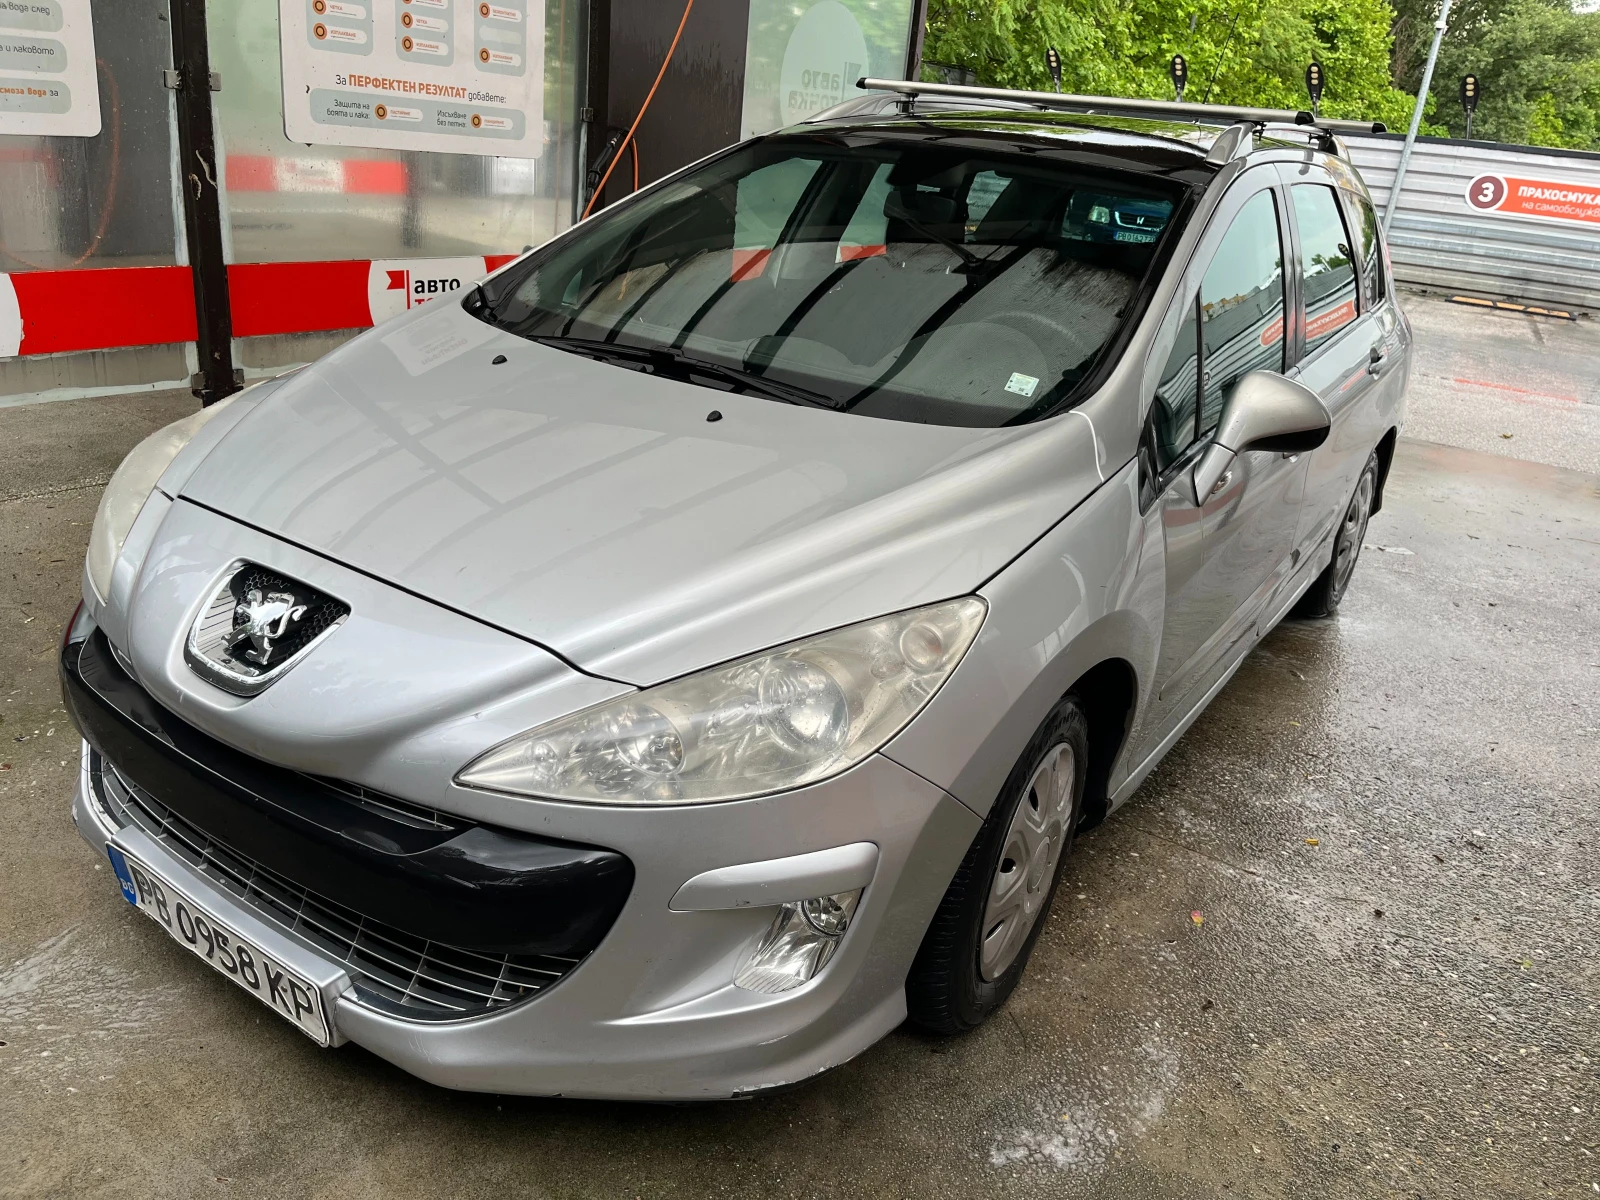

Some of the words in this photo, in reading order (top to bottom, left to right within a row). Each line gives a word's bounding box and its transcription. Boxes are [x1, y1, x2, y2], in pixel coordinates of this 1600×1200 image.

[49, 89, 59, 97] за
[335, 74, 347, 86] За
[348, 74, 416, 93] ПЕРФЕКТЕН
[418, 82, 467, 99] РЕЗУЛТАТ
[334, 98, 361, 109] Защита
[327, 107, 348, 117] боята
[437, 117, 446, 126] без
[1477, 181, 1495, 203] 3
[1522, 201, 1534, 210] на
[414, 278, 460, 294] авто
[121, 878, 134, 895] BG
[176, 902, 261, 989] 0958
